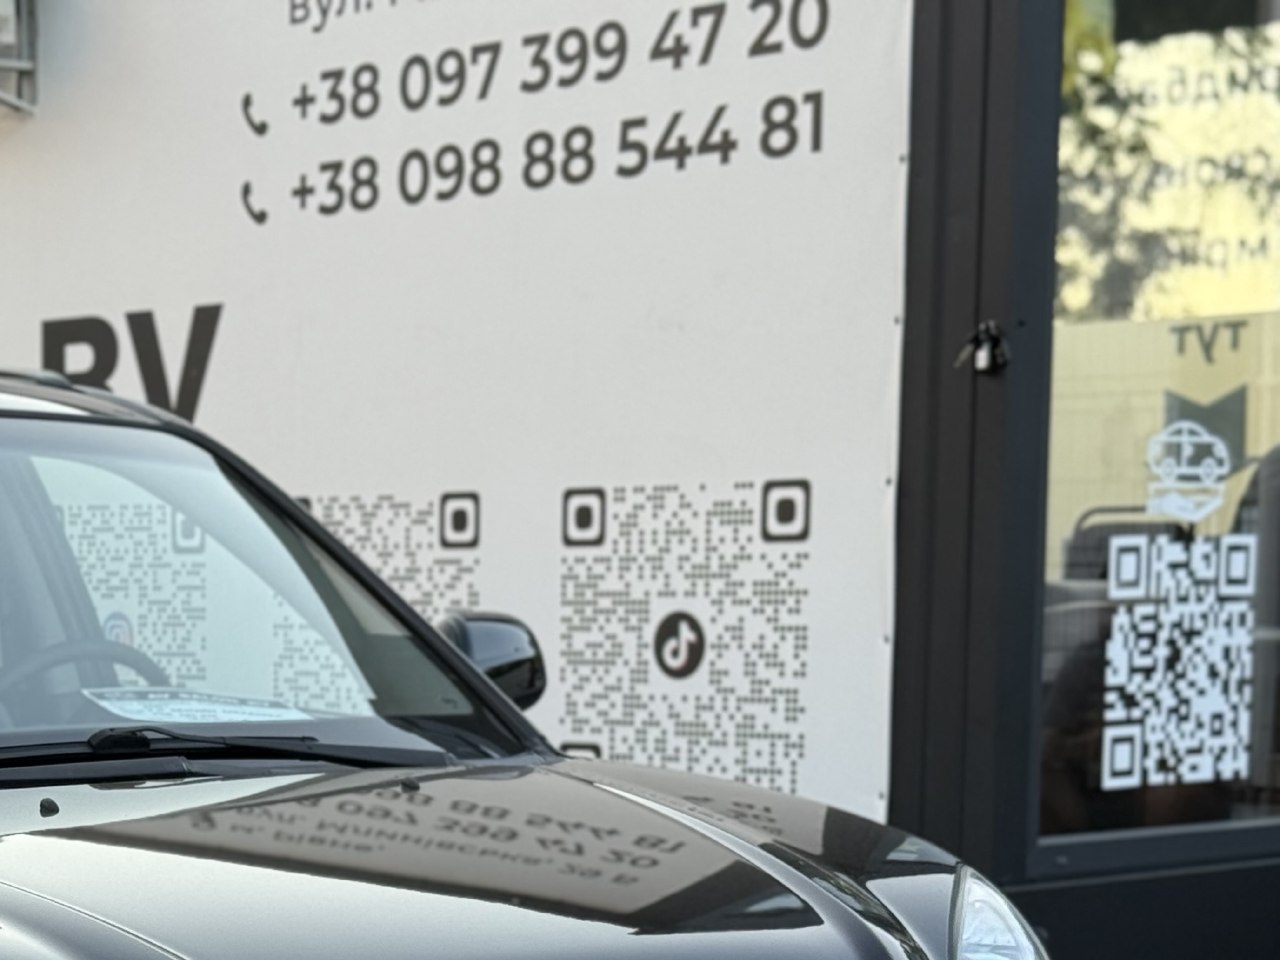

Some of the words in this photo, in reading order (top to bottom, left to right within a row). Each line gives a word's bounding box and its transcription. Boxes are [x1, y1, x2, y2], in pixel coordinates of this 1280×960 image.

[292, 63, 380, 125] +38
[399, 41, 502, 112] 097
[520, 21, 628, 93] 399
[649, 2, 727, 70] 47
[748, 0, 830, 57] 20
[292, 156, 379, 216] +38
[398, 138, 502, 205] 098
[522, 125, 595, 190] 88
[616, 105, 738, 178] 544
[759, 90, 823, 159] 81
[41, 303, 222, 424] RV
